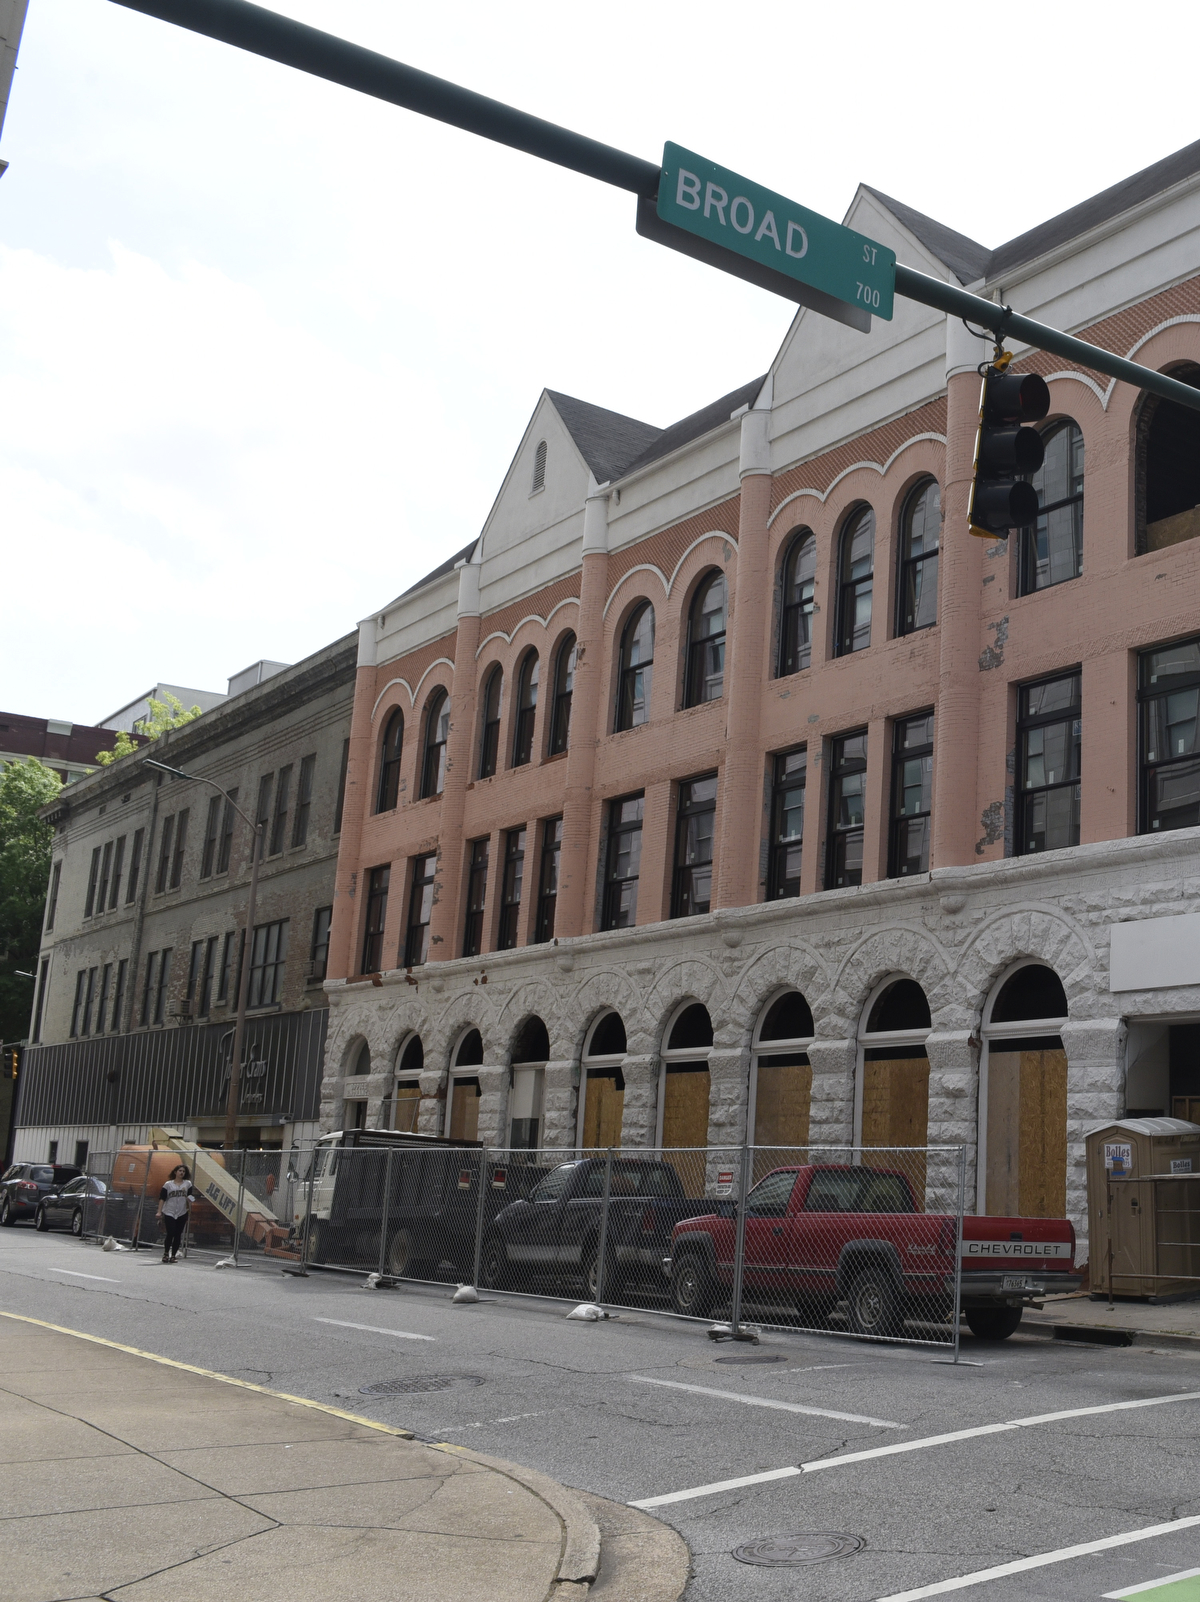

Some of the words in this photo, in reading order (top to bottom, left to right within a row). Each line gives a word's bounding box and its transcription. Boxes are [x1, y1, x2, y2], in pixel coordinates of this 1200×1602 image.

[676, 168, 809, 259] BROAD
[863, 245, 877, 266] ST
[856, 282, 880, 308] 700
[1106, 1145, 1130, 1157] Bolles
[1172, 1161, 1191, 1169] Bolles
[205, 1182, 221, 1202] JLG
[219, 1192, 237, 1216] LIFT
[969, 1243, 1061, 1255] CHEVROLET
